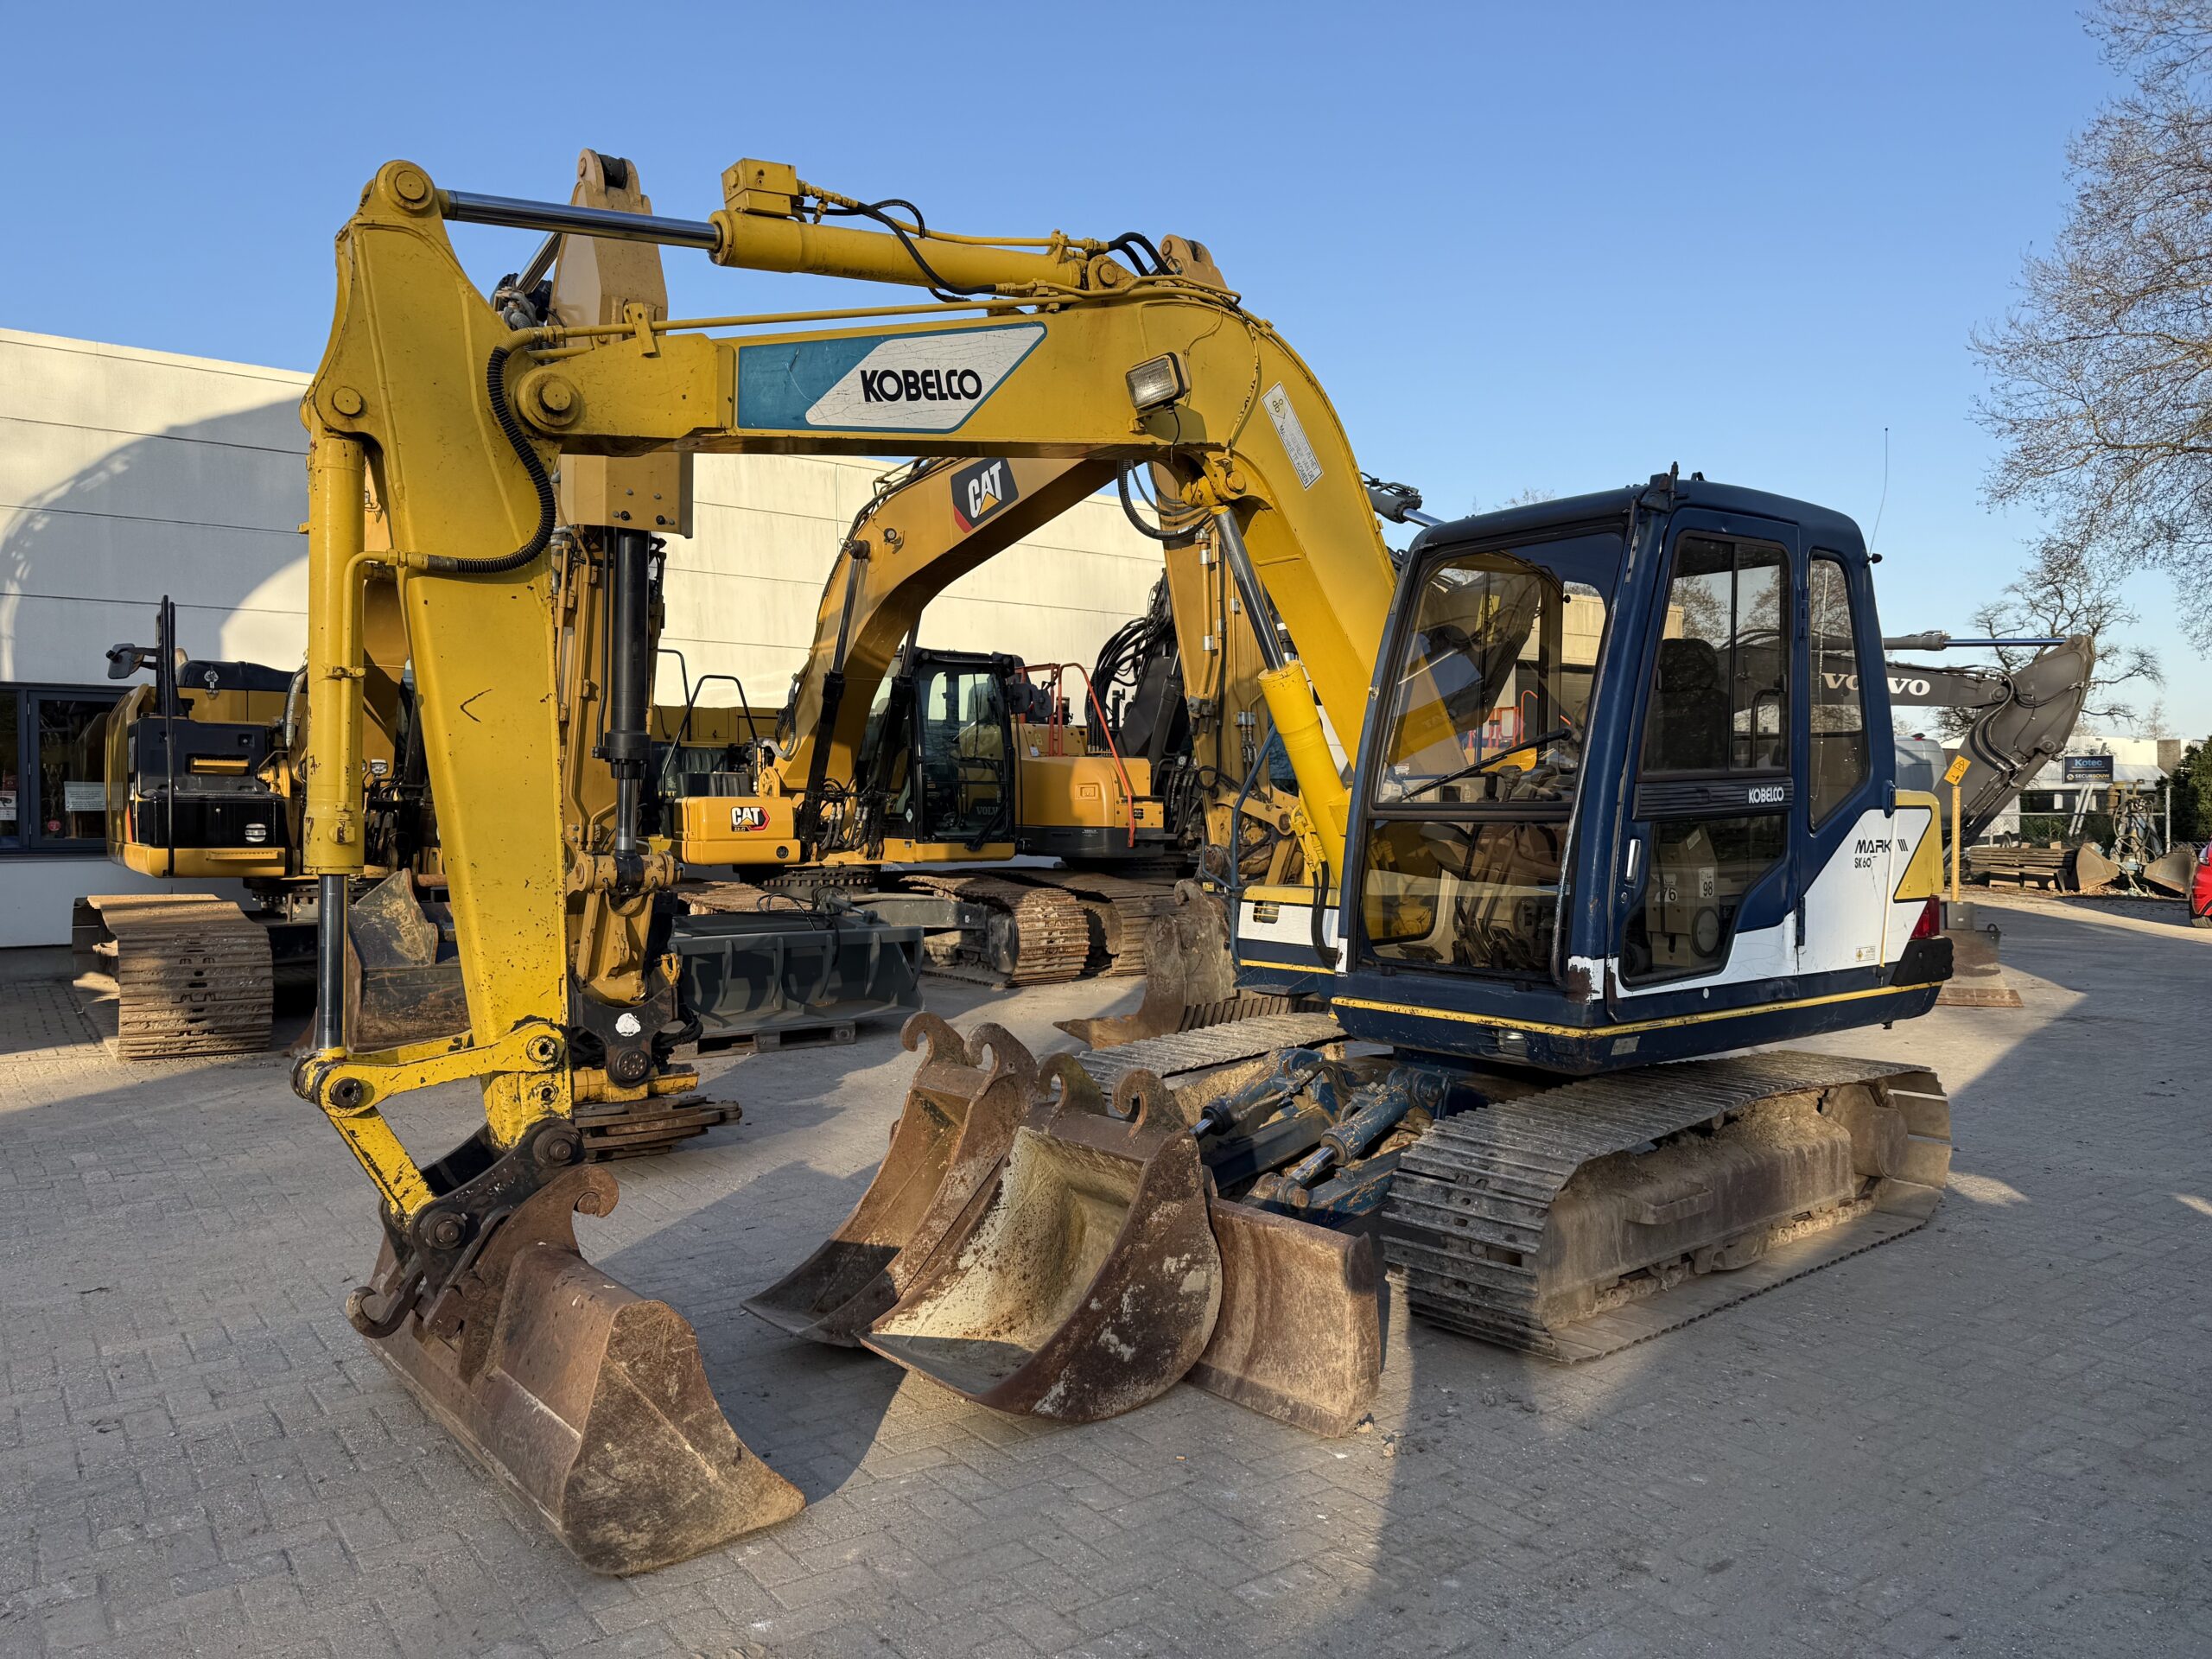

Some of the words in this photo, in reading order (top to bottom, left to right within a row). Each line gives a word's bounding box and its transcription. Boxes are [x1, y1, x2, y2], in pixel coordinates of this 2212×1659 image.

[860, 369, 982, 402] KOBELCO
[1292, 453, 1298, 462] TE
[1295, 461, 1309, 485] KOMEN
[1307, 470, 1314, 480] DE
[968, 461, 1002, 518] CAT
[1821, 672, 1930, 696] VOVO
[1748, 786, 1784, 804] KOBELCO
[731, 807, 760, 826] CAT
[976, 805, 999, 816] VOLV
[1854, 839, 1891, 854] MARK
[1703, 881, 1713, 897] 98
